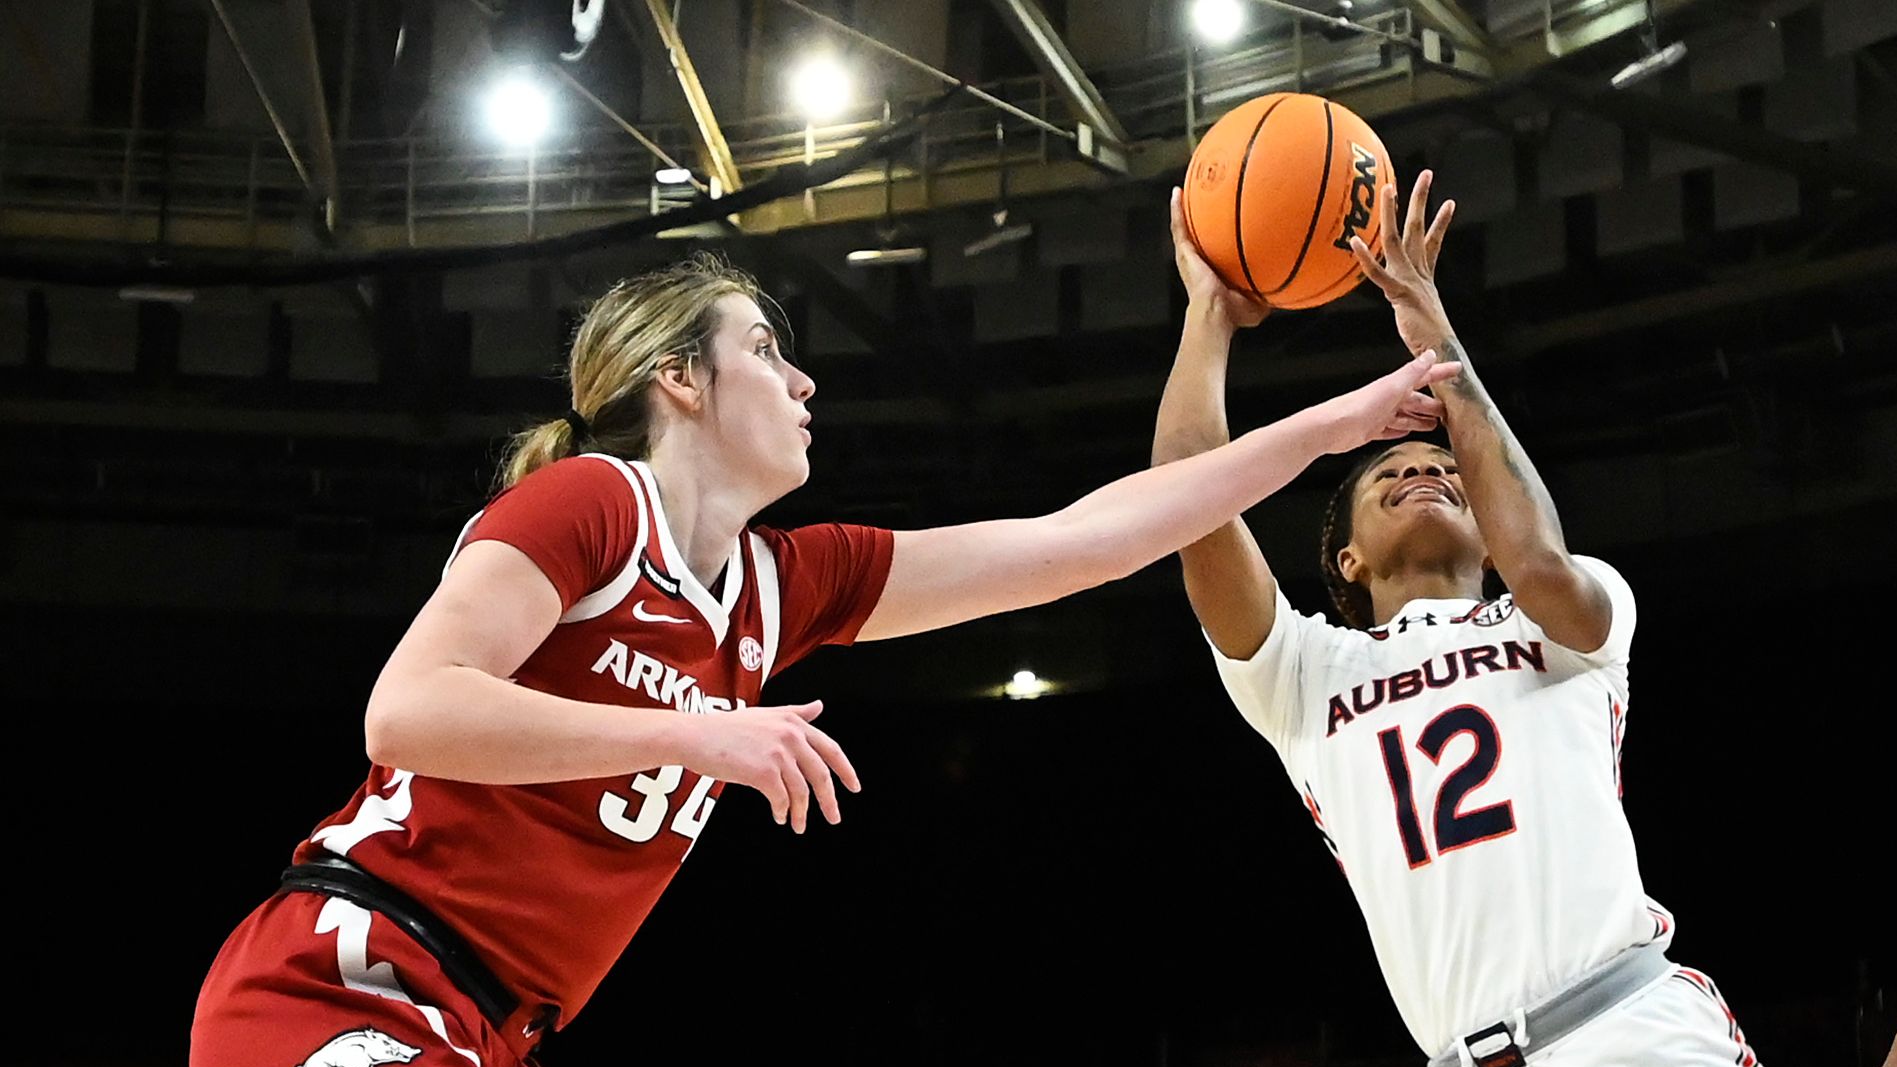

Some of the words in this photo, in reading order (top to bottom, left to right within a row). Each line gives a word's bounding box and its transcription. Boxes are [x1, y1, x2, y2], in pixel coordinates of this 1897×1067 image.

[1473, 597, 1513, 626] SEC
[1326, 641, 1547, 737] AUBURN
[599, 765, 716, 863] 34
[1377, 704, 1517, 870] 12
